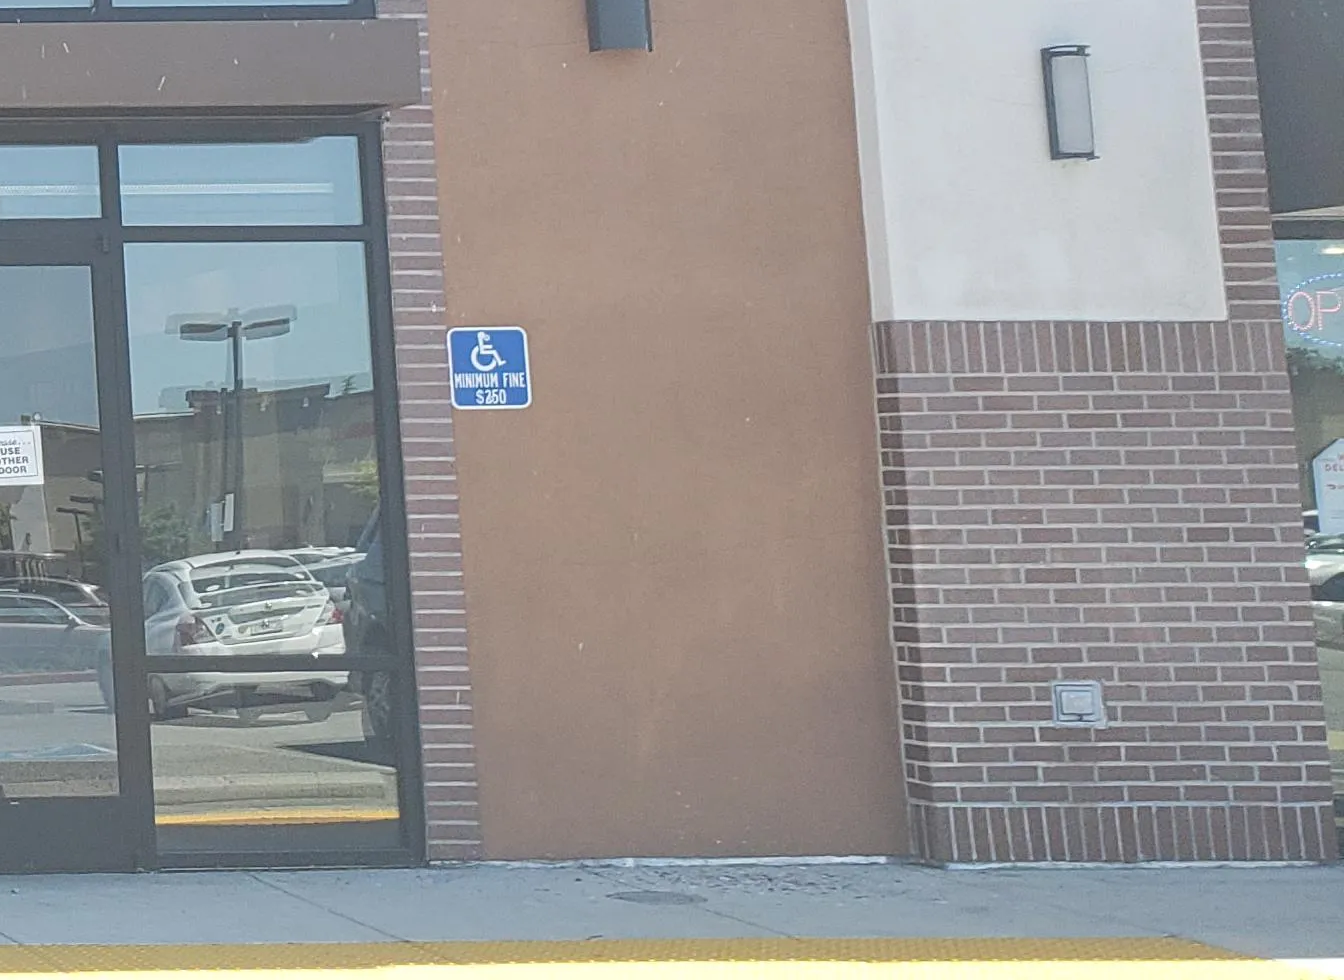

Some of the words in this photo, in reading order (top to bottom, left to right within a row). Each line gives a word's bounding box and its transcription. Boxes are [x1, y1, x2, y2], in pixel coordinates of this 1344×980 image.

[454, 372, 499, 388] MINIMUM
[502, 372, 526, 388] FINE
[475, 389, 507, 405] $250
[0, 447, 21, 456] USE
